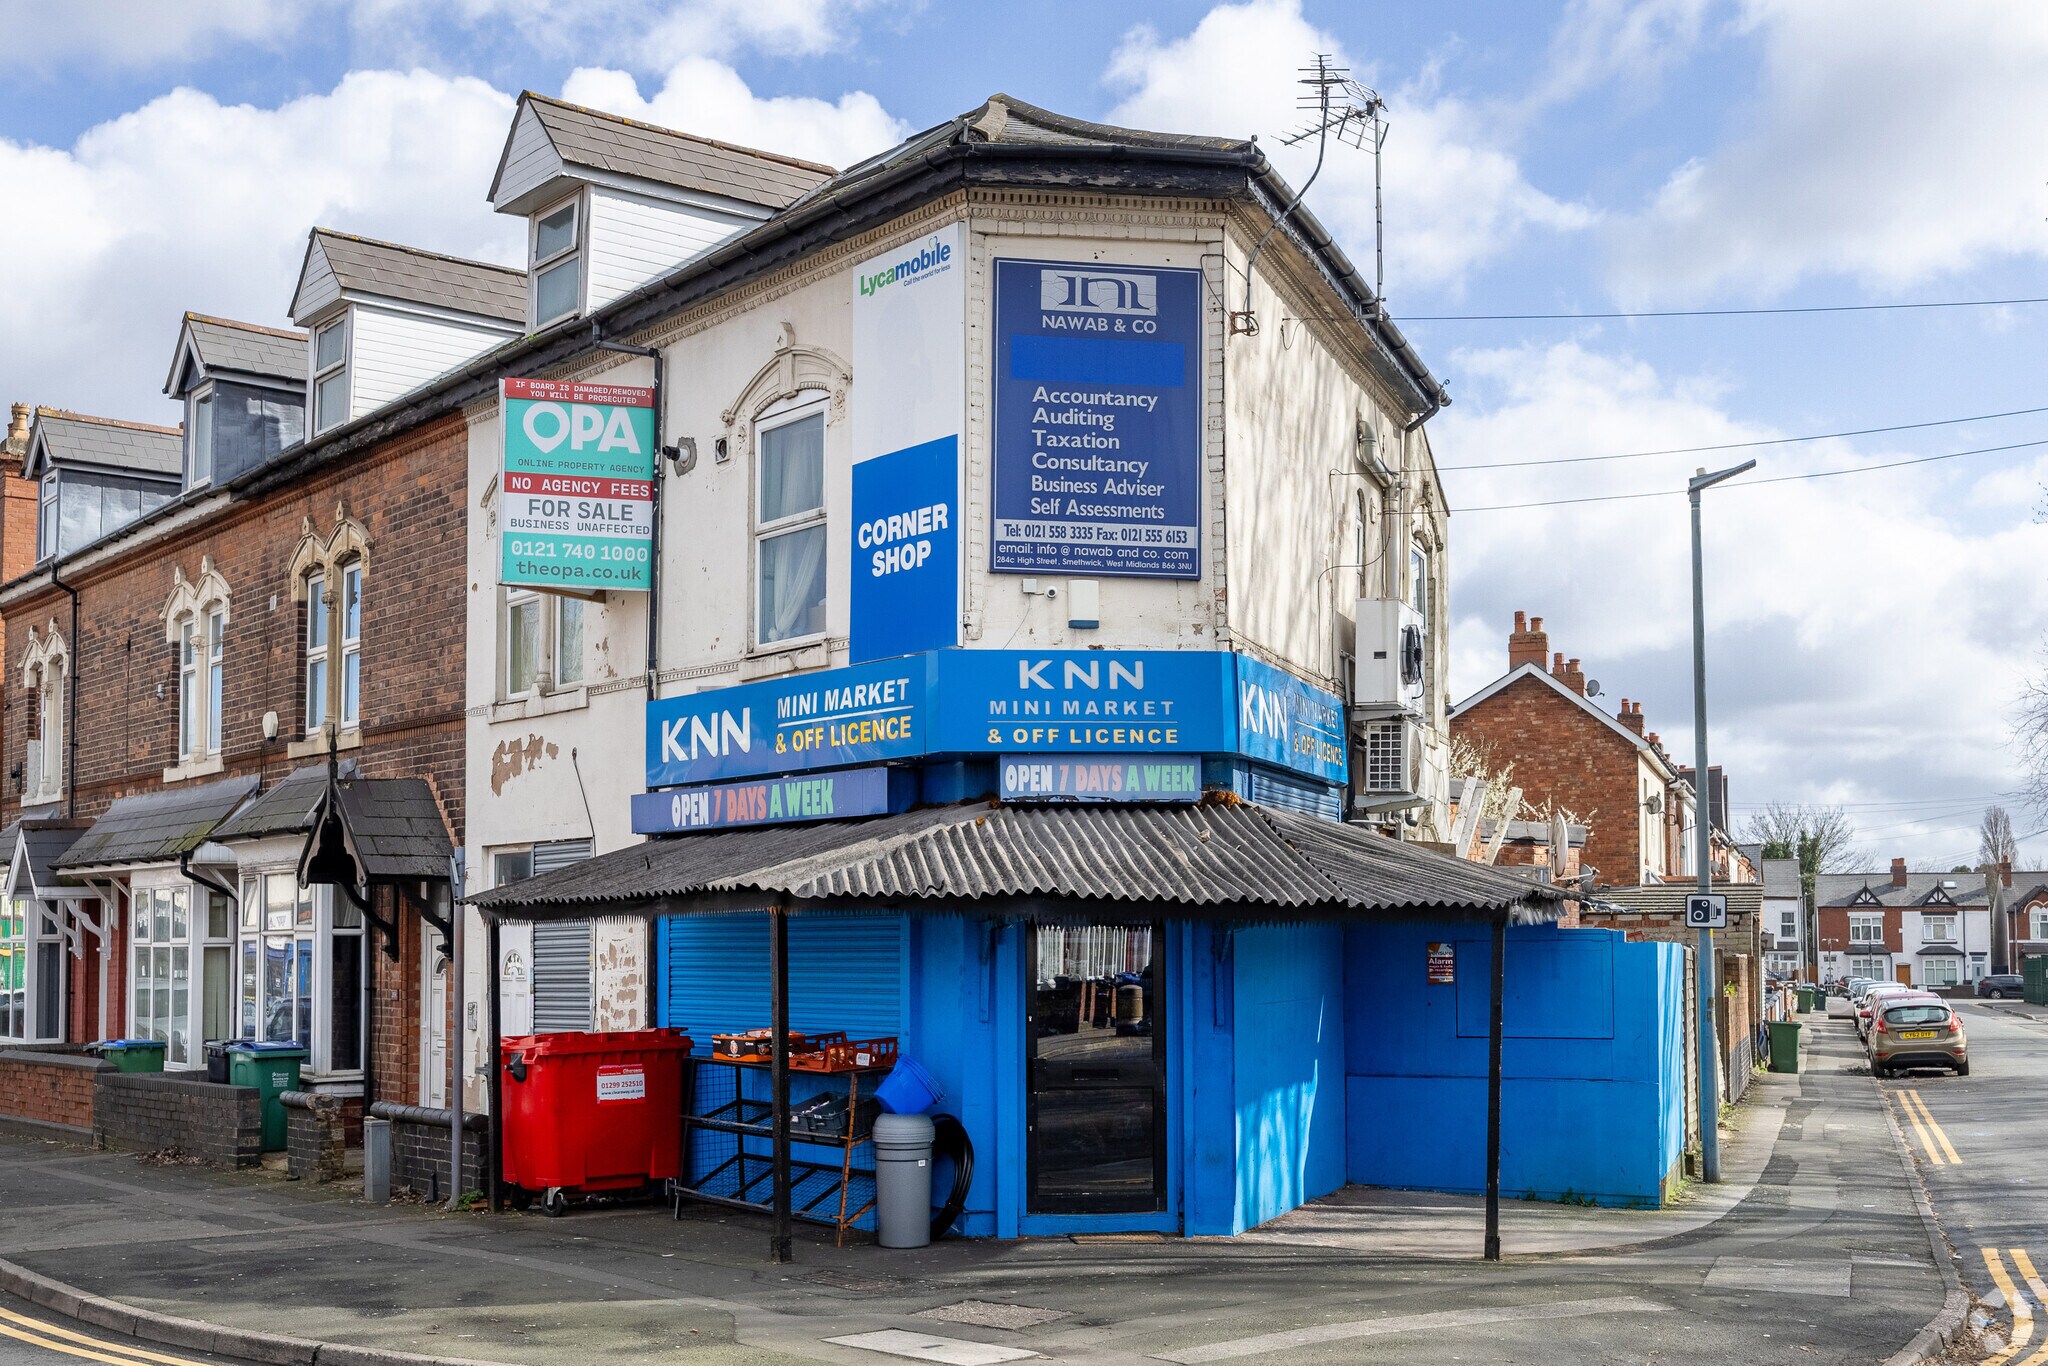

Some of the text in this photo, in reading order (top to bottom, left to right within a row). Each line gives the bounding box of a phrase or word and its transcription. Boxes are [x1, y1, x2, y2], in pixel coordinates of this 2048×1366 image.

[860, 242, 951, 296] Lycamobile
[1042, 315, 1157, 334] NAWAB & CO
[530, 382, 555, 390] BOARD
[588, 395, 637, 404] PROSECUTED
[1032, 386, 1158, 413] Accountancy
[523, 401, 641, 454] OPA
[1032, 407, 1115, 431] Auditing
[1031, 429, 1120, 450] Taxation
[518, 459, 645, 474] ONLINE PROPERTY AGENCY
[1032, 452, 1149, 479] Consultancy
[512, 477, 650, 497] NO AGENCY FEES
[1031, 475, 1165, 497] Business Adviser
[528, 499, 633, 522] FOR SALE
[1030, 497, 1165, 520] Self Assessments
[510, 518, 650, 535] BUSINESS UNAFFECTED
[858, 503, 948, 549] CORNER
[1003, 523, 1188, 544] Tel: 0121 558 3335 Fax: 0121 555 6153
[511, 540, 648, 563] 0121 740 1000
[872, 540, 931, 578] SHOP
[996, 555, 1015, 564] 284c
[1017, 557, 1035, 566] High
[1125, 560, 1160, 569] Midlands
[1161, 562, 1176, 570] B66
[998, 543, 1189, 560] email: info @ nawab and co. com
[516, 561, 642, 580] theopa.co.uk
[1019, 659, 1144, 690] KNN
[777, 677, 910, 719] MINI MARKET
[989, 700, 1174, 716] MINI MARKET
[1241, 680, 1288, 743] KNN
[1312, 701, 1338, 729] MARKET
[661, 706, 751, 764] KNN
[775, 715, 912, 755] & OFF LICENCE
[987, 728, 1178, 744] & OFF LICENCE
[1301, 734, 1315, 756] OFF
[1316, 740, 1343, 767] LICENCE
[1005, 764, 1195, 792] OPEN 7 DAYS A WEEK
[671, 778, 834, 827] OPEN 7 DAYS A WEEK
[621, 1080, 643, 1088] 252510
